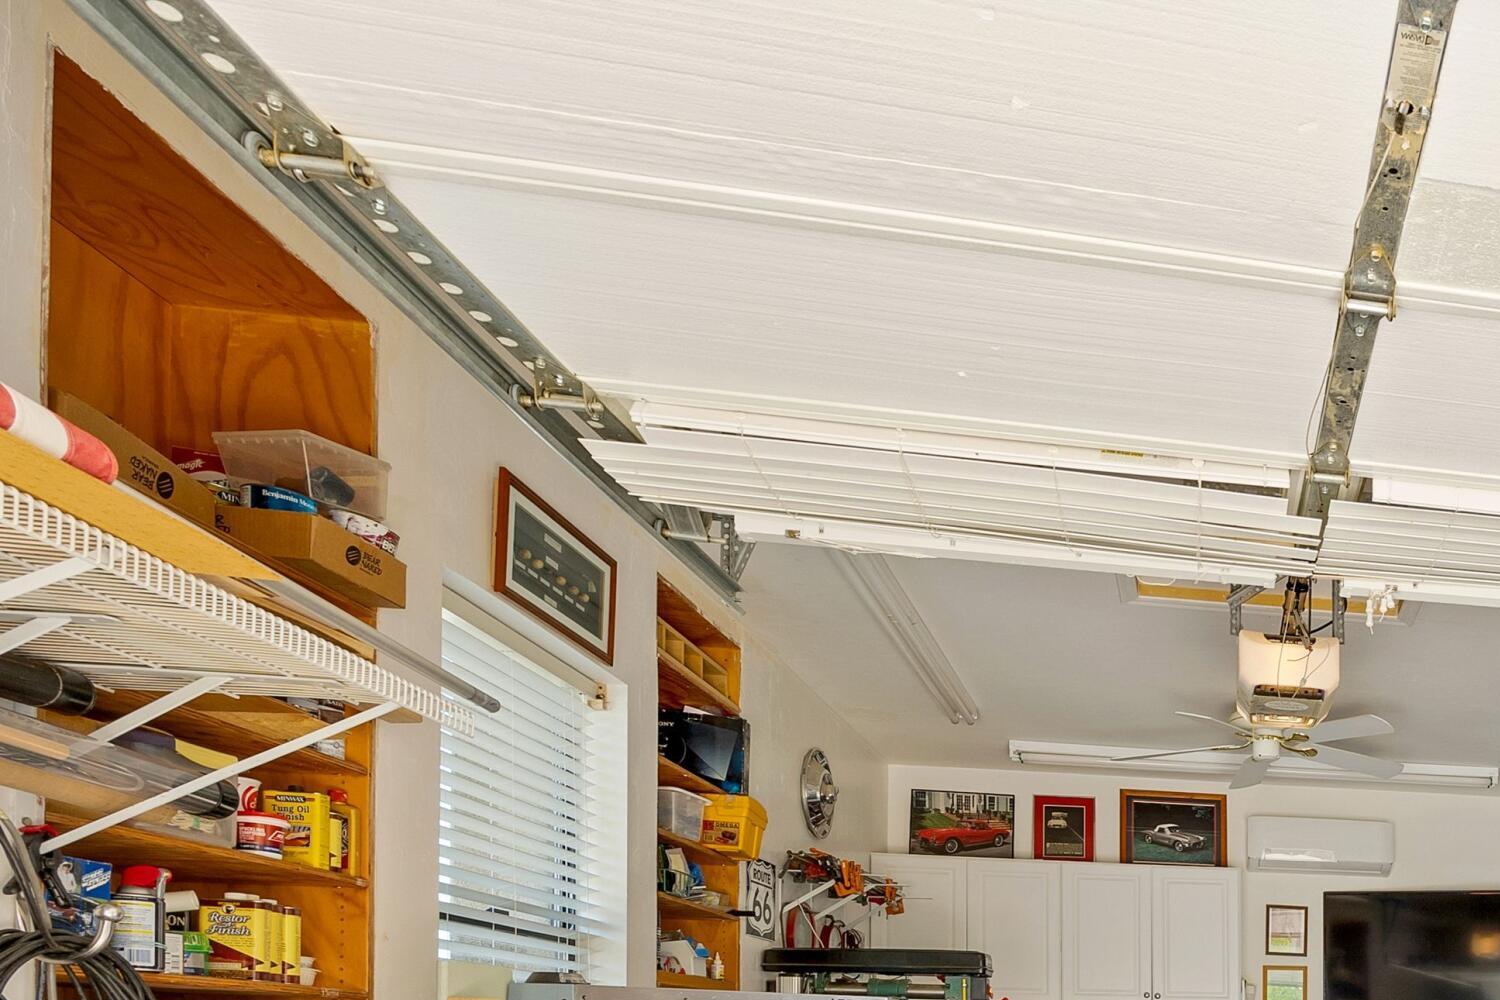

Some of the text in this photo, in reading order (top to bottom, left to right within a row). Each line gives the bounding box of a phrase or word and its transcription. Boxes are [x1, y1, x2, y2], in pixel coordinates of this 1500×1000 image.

[262, 488, 299, 504] Benjamin
[276, 795, 305, 803] MINWAX
[271, 804, 294, 814] Tung
[753, 867, 771, 885] ROUTE
[753, 887, 772, 925] 66
[208, 911, 250, 923] Restor
[205, 925, 251, 936] Finish
